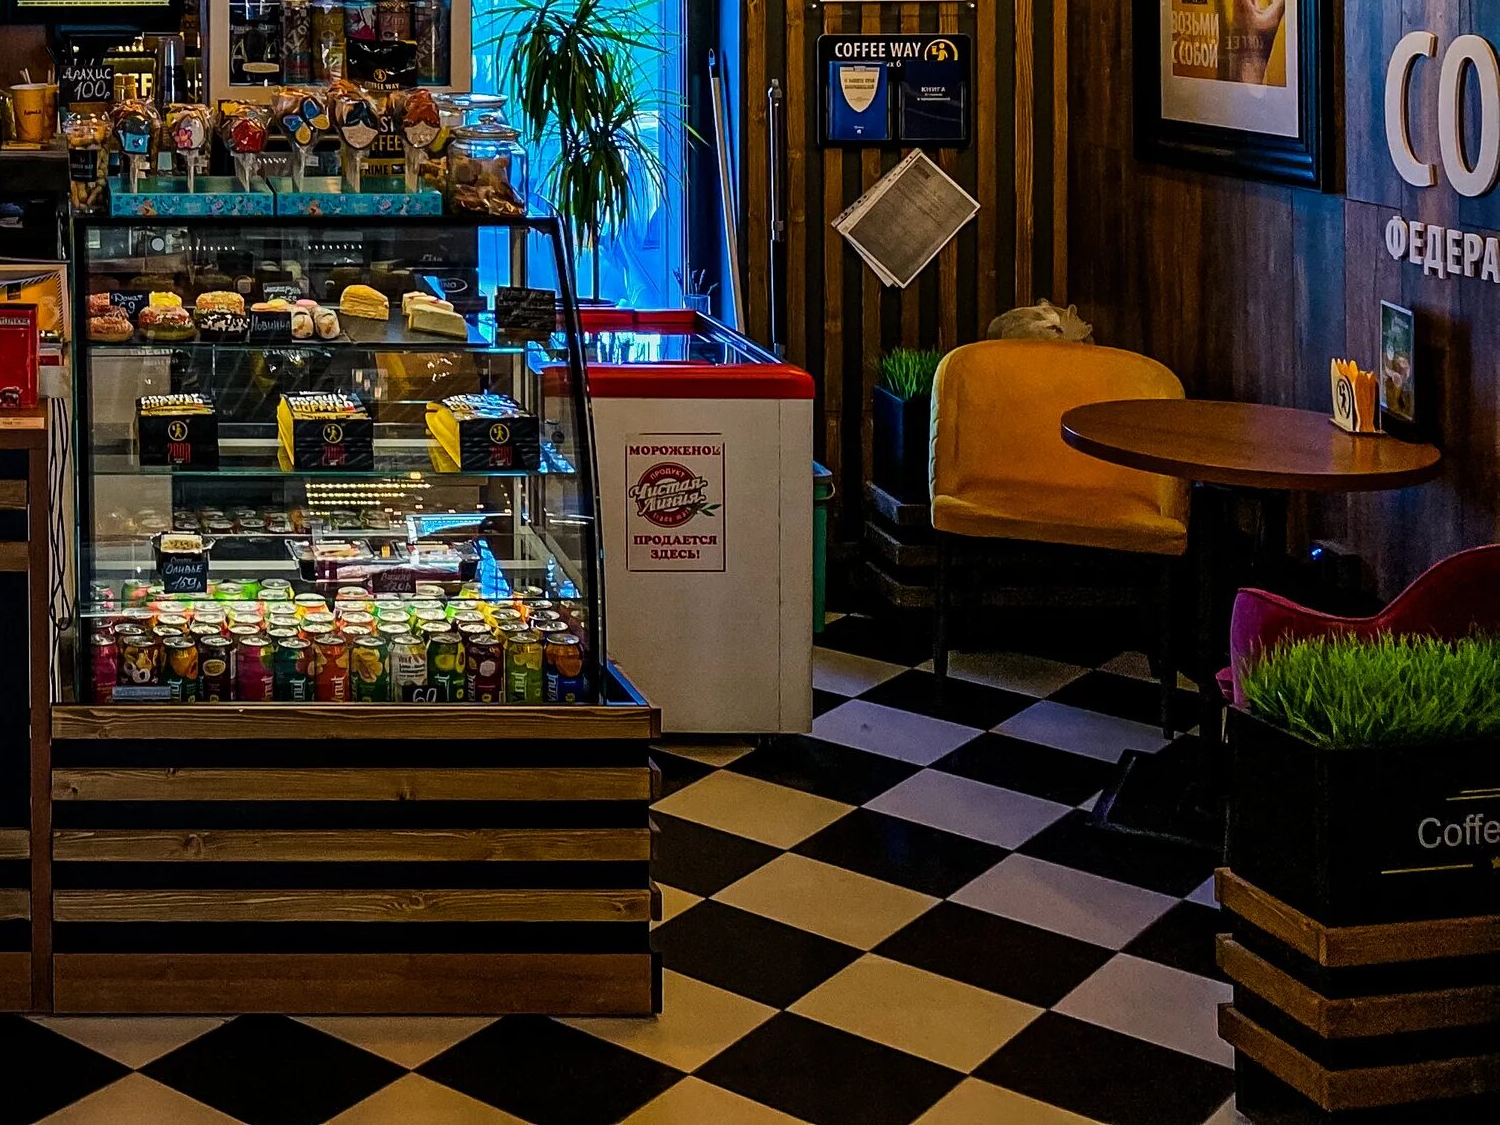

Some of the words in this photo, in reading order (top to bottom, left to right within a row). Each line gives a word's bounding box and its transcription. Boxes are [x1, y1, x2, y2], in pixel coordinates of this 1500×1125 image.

[1171, 11, 1220, 37] ВОЗЬМИ
[834, 42, 886, 58] COFFEE
[889, 41, 921, 58] WAY
[1179, 39, 1219, 68] СОБОЙ
[62, 67, 112, 82] АРАХИС
[1384, 31, 1500, 197] CO
[1385, 215, 1500, 284] ФЕДЕРА
[650, 467, 686, 480] ПРОДУКТ
[629, 476, 708, 500] Чистая
[637, 492, 707, 517] Линия
[633, 535, 717, 546] ПРОДАЕТСЯ
[650, 550, 701, 560] ЗДЕСЬ!
[1417, 813, 1500, 849] Coffe
